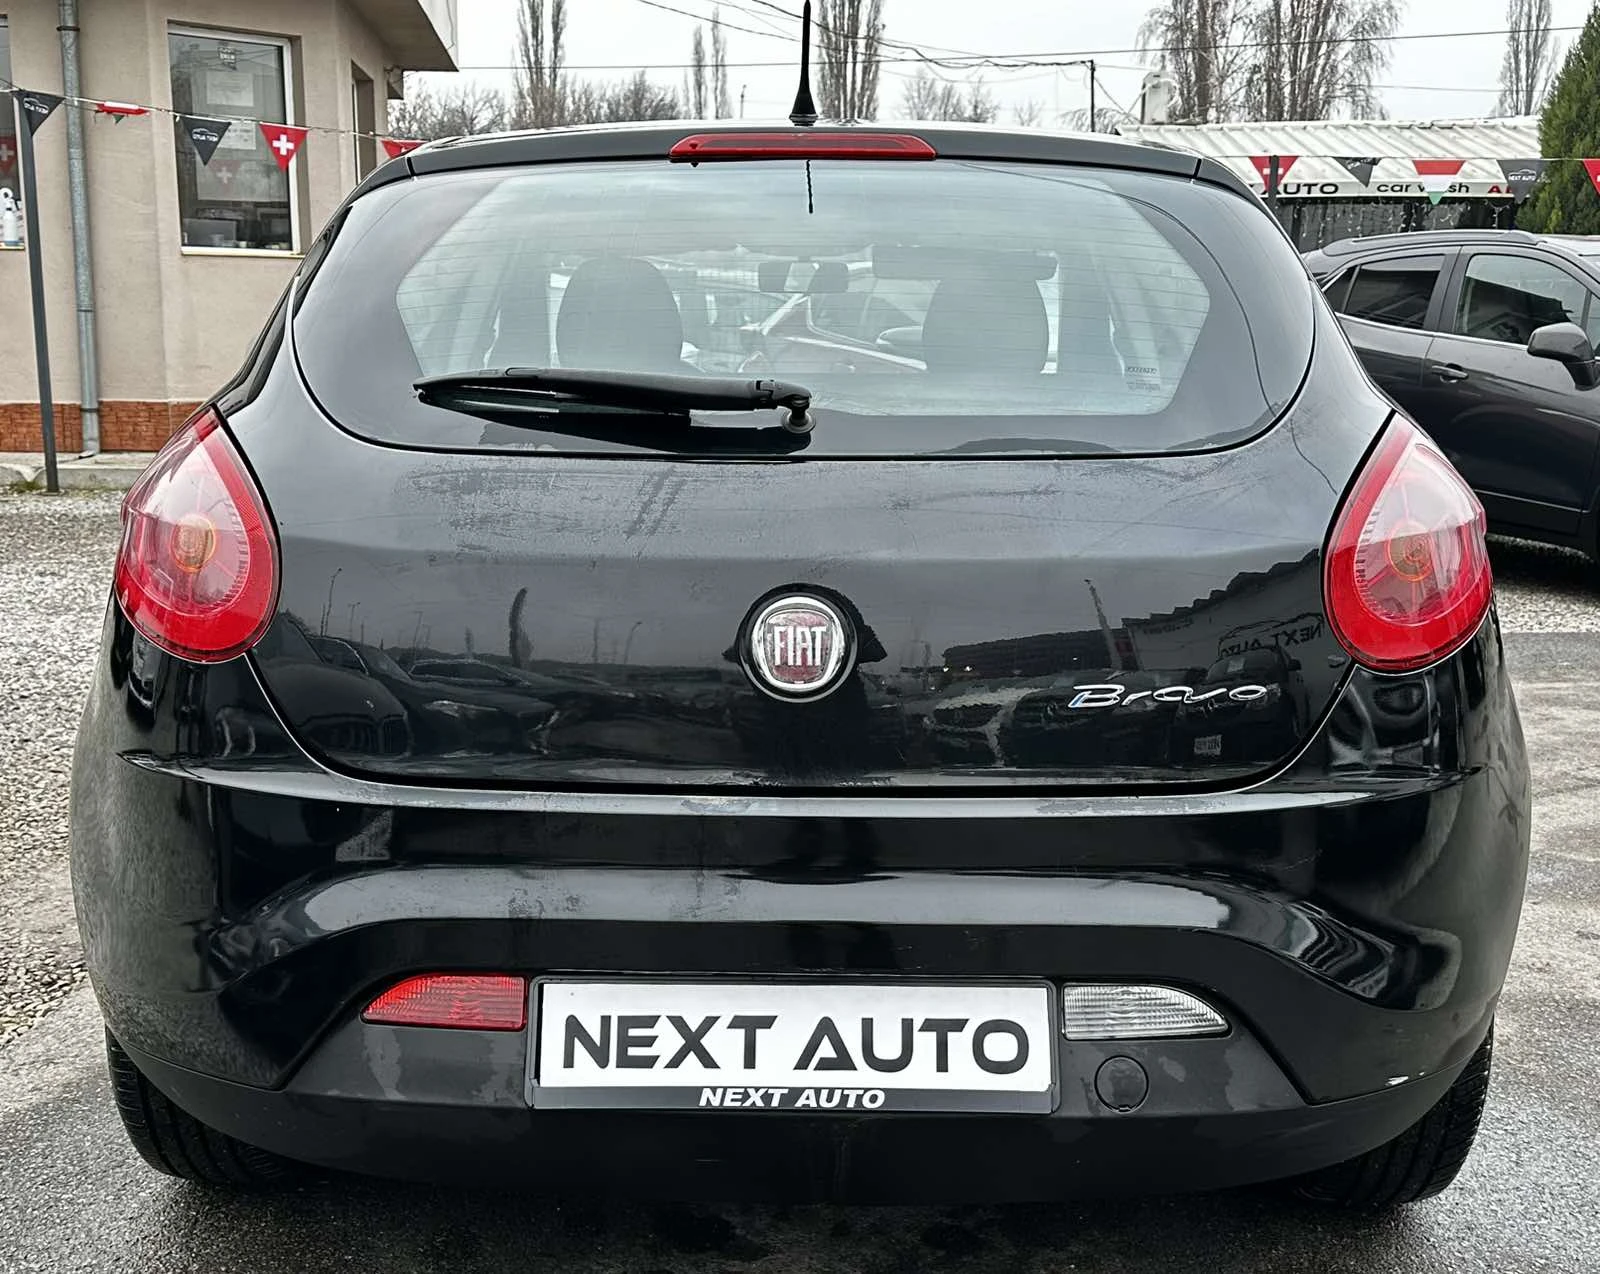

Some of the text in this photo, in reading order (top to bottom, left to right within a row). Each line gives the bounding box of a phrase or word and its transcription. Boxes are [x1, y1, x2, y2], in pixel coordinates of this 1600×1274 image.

[1376, 182, 1470, 193] car sh
[773, 625, 827, 666] FIAT
[1067, 683, 1268, 709] Bravo
[562, 1014, 1030, 1075] NEXT AUTO
[698, 1087, 886, 1109] NEXT AUTO
